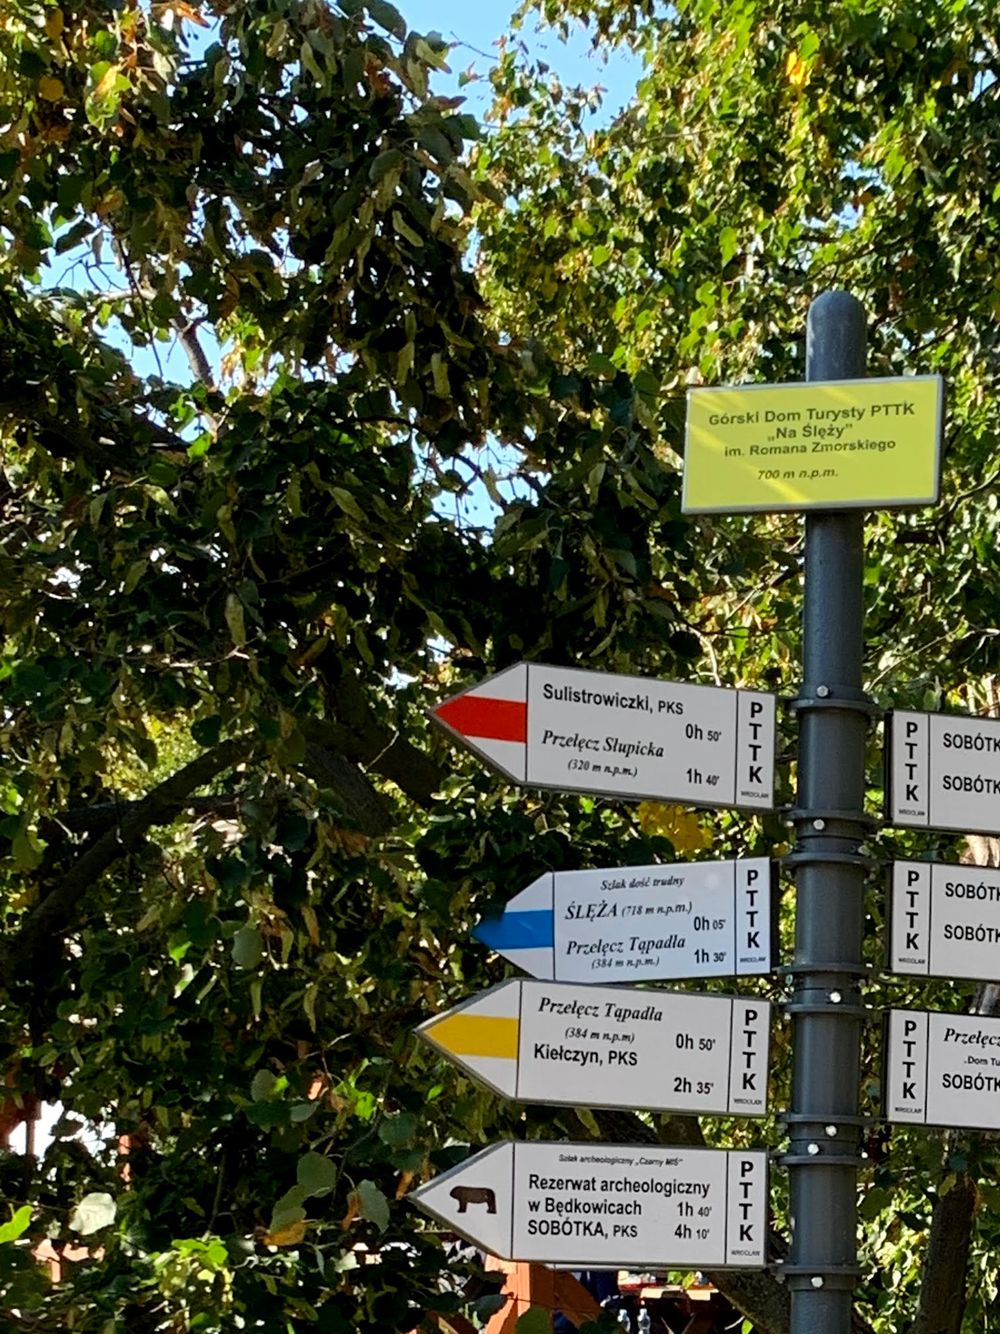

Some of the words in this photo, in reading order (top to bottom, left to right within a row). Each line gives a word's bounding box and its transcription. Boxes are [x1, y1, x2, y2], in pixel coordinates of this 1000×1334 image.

[709, 413, 759, 425] Górski
[764, 410, 801, 423] Dom
[806, 406, 865, 422] Turysty
[871, 403, 915, 417] PTTK
[724, 447, 745, 457] im.
[750, 444, 807, 456] Romana
[812, 439, 896, 453] Zmorskiego
[757, 470, 780, 480] 700
[783, 471, 795, 480] m
[799, 468, 839, 480] n.p.m.
[543, 683, 654, 714] Sulistrowiczki,
[658, 701, 684, 716] PKS
[685, 724, 703, 741] 0h
[748, 702, 763, 784] PTTK
[542, 729, 600, 753] Przełęcz
[602, 737, 665, 759] Słupicka
[568, 758, 590, 771] (320
[592, 763, 602, 773] m
[905, 722, 918, 801] PTTK
[686, 768, 702, 785] 1h
[600, 879, 627, 891] Szlak
[629, 876, 650, 889] dość
[651, 875, 686, 890] trudny
[565, 900, 618, 921] ŚLĘŻA
[621, 904, 643, 918] (718
[645, 906, 655, 915] m
[746, 869, 760, 949] PTTK
[906, 871, 919, 950] PTTK
[693, 916, 710, 931] 0h
[566, 940, 623, 956] Przełęcz
[629, 935, 686, 954] Tąpadła
[614, 959, 624, 968] m
[694, 949, 710, 964] 1h
[538, 996, 600, 1018] Przełęcz
[604, 1002, 663, 1022] Tąpadła
[565, 1027, 588, 1040] (384
[590, 1031, 600, 1041] m
[675, 1033, 694, 1050] 0h
[534, 1044, 603, 1067] Kiełczyn,
[608, 1050, 638, 1066] PKS
[742, 1009, 758, 1091] PTTK
[902, 1020, 916, 1099] PTTK
[674, 1077, 692, 1094] 2h
[529, 1174, 596, 1192] Rezerwat
[600, 1177, 710, 1198] archeologiczny
[528, 1201, 541, 1213] w
[545, 1198, 642, 1218] Będkowicach
[678, 1202, 694, 1217] 1h
[739, 1161, 754, 1242] PTTK
[528, 1218, 608, 1239] SOBÓTKA,
[613, 1225, 638, 1238] PKS
[674, 1223, 692, 1239] 4h
